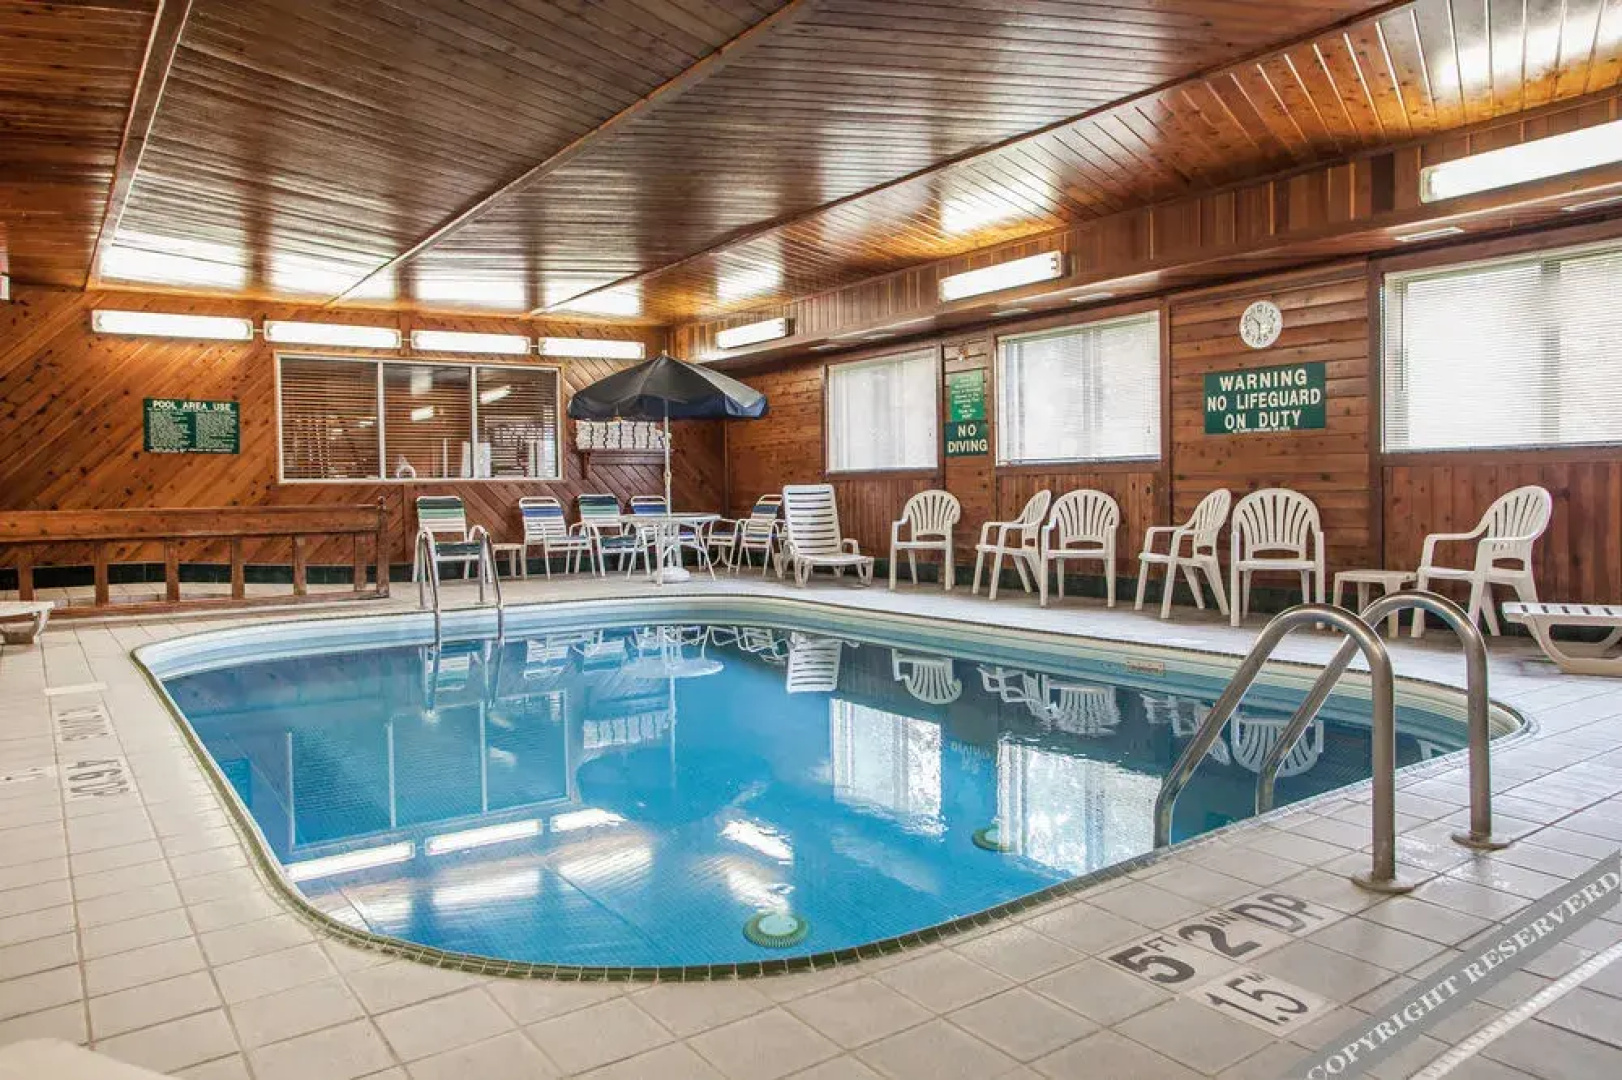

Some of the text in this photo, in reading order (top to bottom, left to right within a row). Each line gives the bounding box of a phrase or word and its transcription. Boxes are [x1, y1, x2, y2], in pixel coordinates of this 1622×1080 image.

[1219, 369, 1308, 392] WARNING
[152, 400, 231, 411] POOL AREA USE
[1207, 388, 1321, 412] NO LIFEGUARD
[1224, 409, 1302, 429] ON DUTY
[957, 424, 977, 438] NO
[947, 439, 989, 453] DIVING
[1230, 892, 1323, 933] DP
